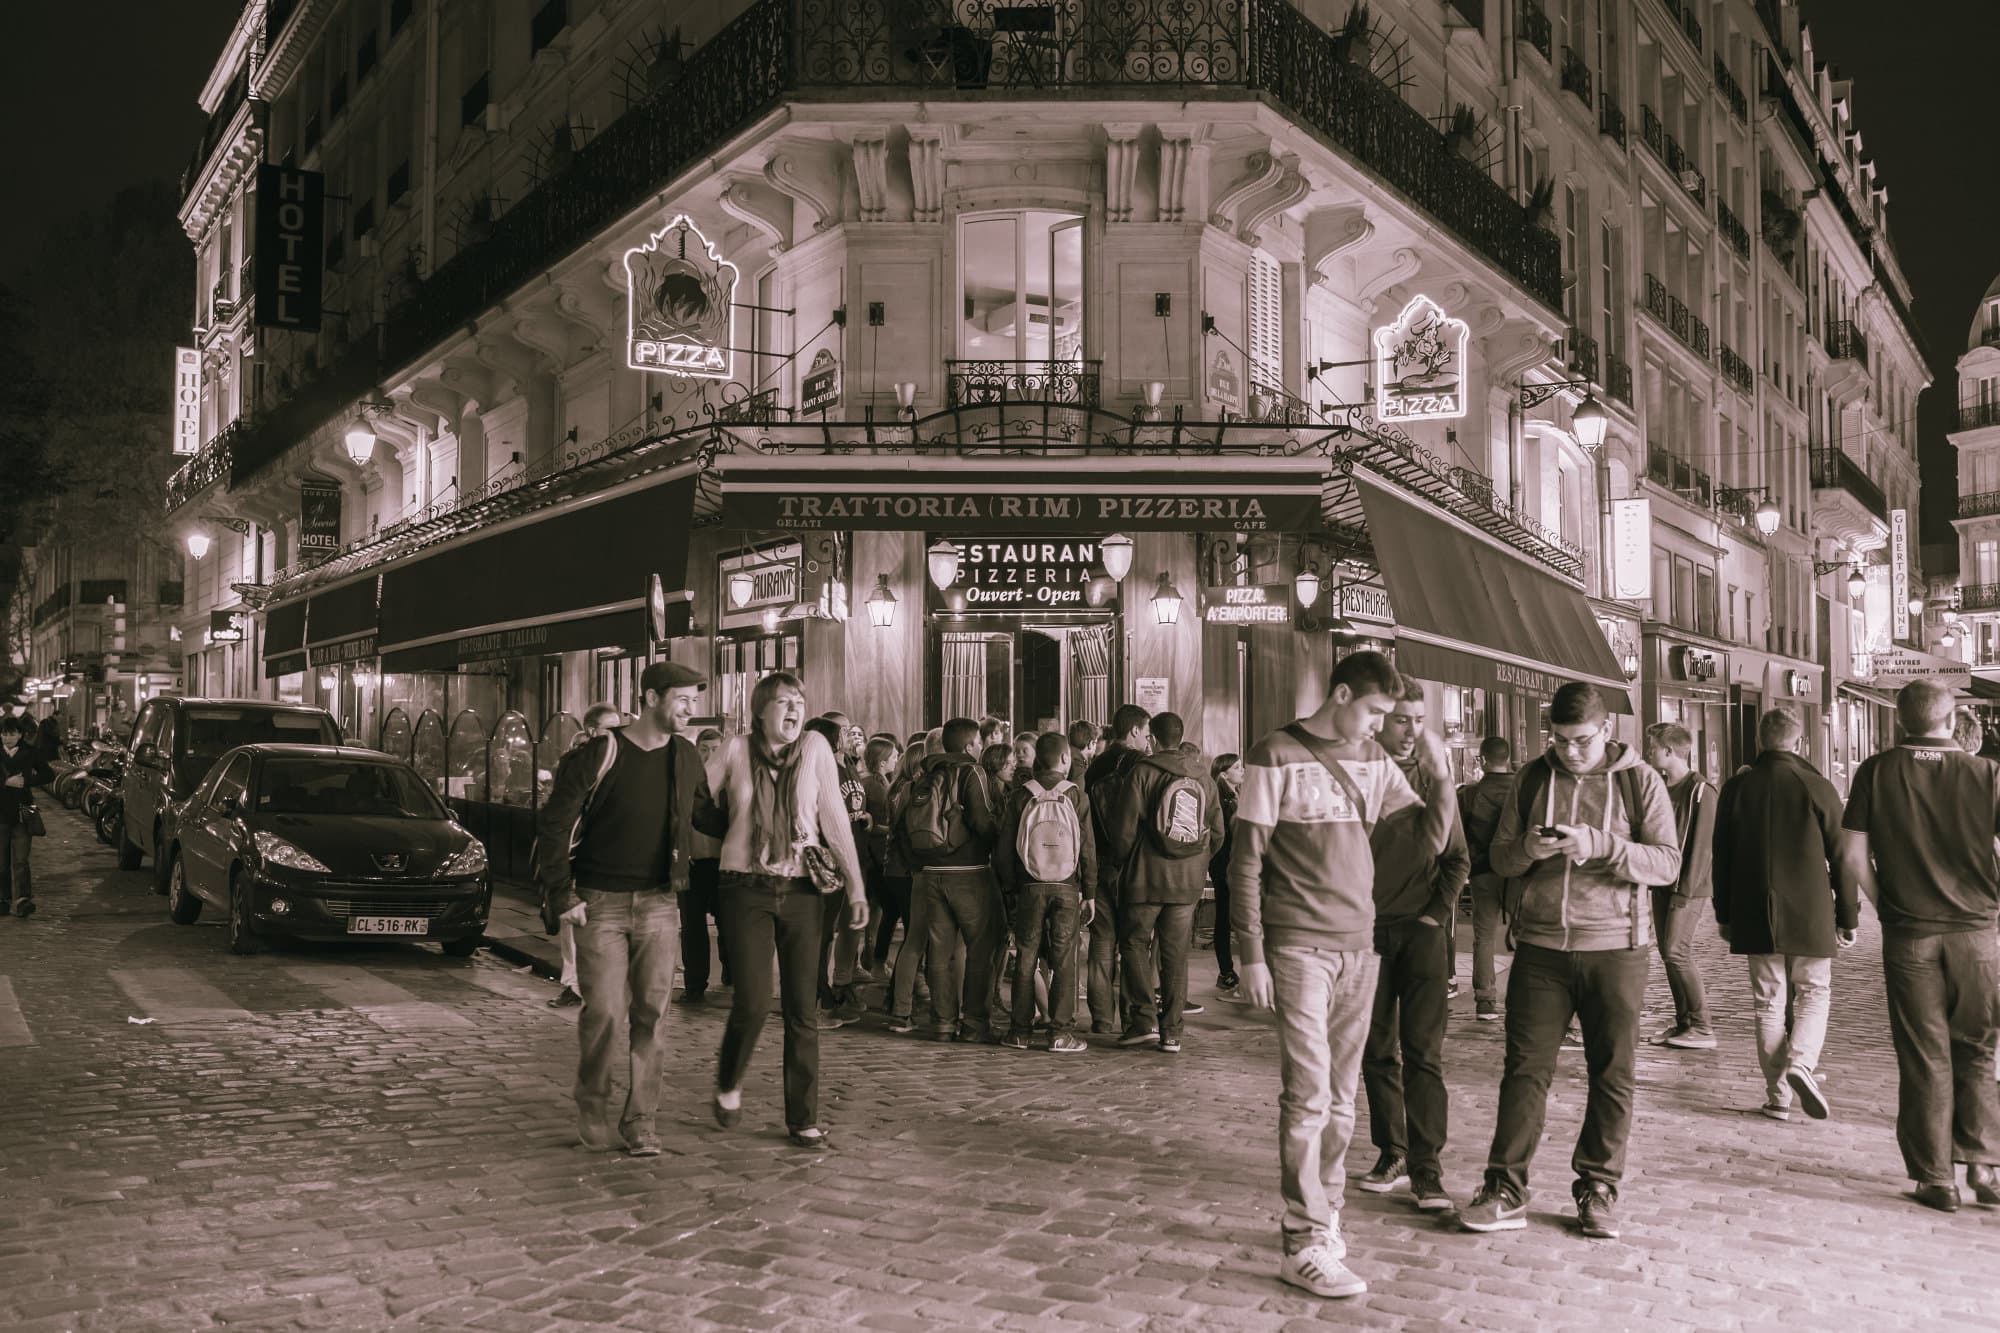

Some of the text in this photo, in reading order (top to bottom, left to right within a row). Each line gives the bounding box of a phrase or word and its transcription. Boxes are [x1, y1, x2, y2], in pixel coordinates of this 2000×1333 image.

[278, 172, 304, 323] HOTEL
[636, 342, 725, 369] PIZZA
[180, 372, 198, 451] HOTEL
[1384, 396, 1455, 416] PIZZA
[778, 496, 1266, 519] TRATTORIA (RIM) PIZZERIA
[776, 519, 822, 527] GELATI
[1234, 521, 1267, 529] CAFE
[302, 534, 338, 546] HOTEL
[954, 544, 1095, 562] ESTAURAN
[750, 569, 793, 601] AURANT
[955, 569, 1091, 582] PIZZERIA
[1894, 515, 1906, 634] GIBERT JEUNE
[966, 587, 1022, 602] Ouvert
[1036, 587, 1081, 605] Open
[1226, 588, 1264, 603] PIZZA
[1345, 587, 1392, 618] RESTAURAN
[1496, 663, 1543, 690] RESTAURANT
